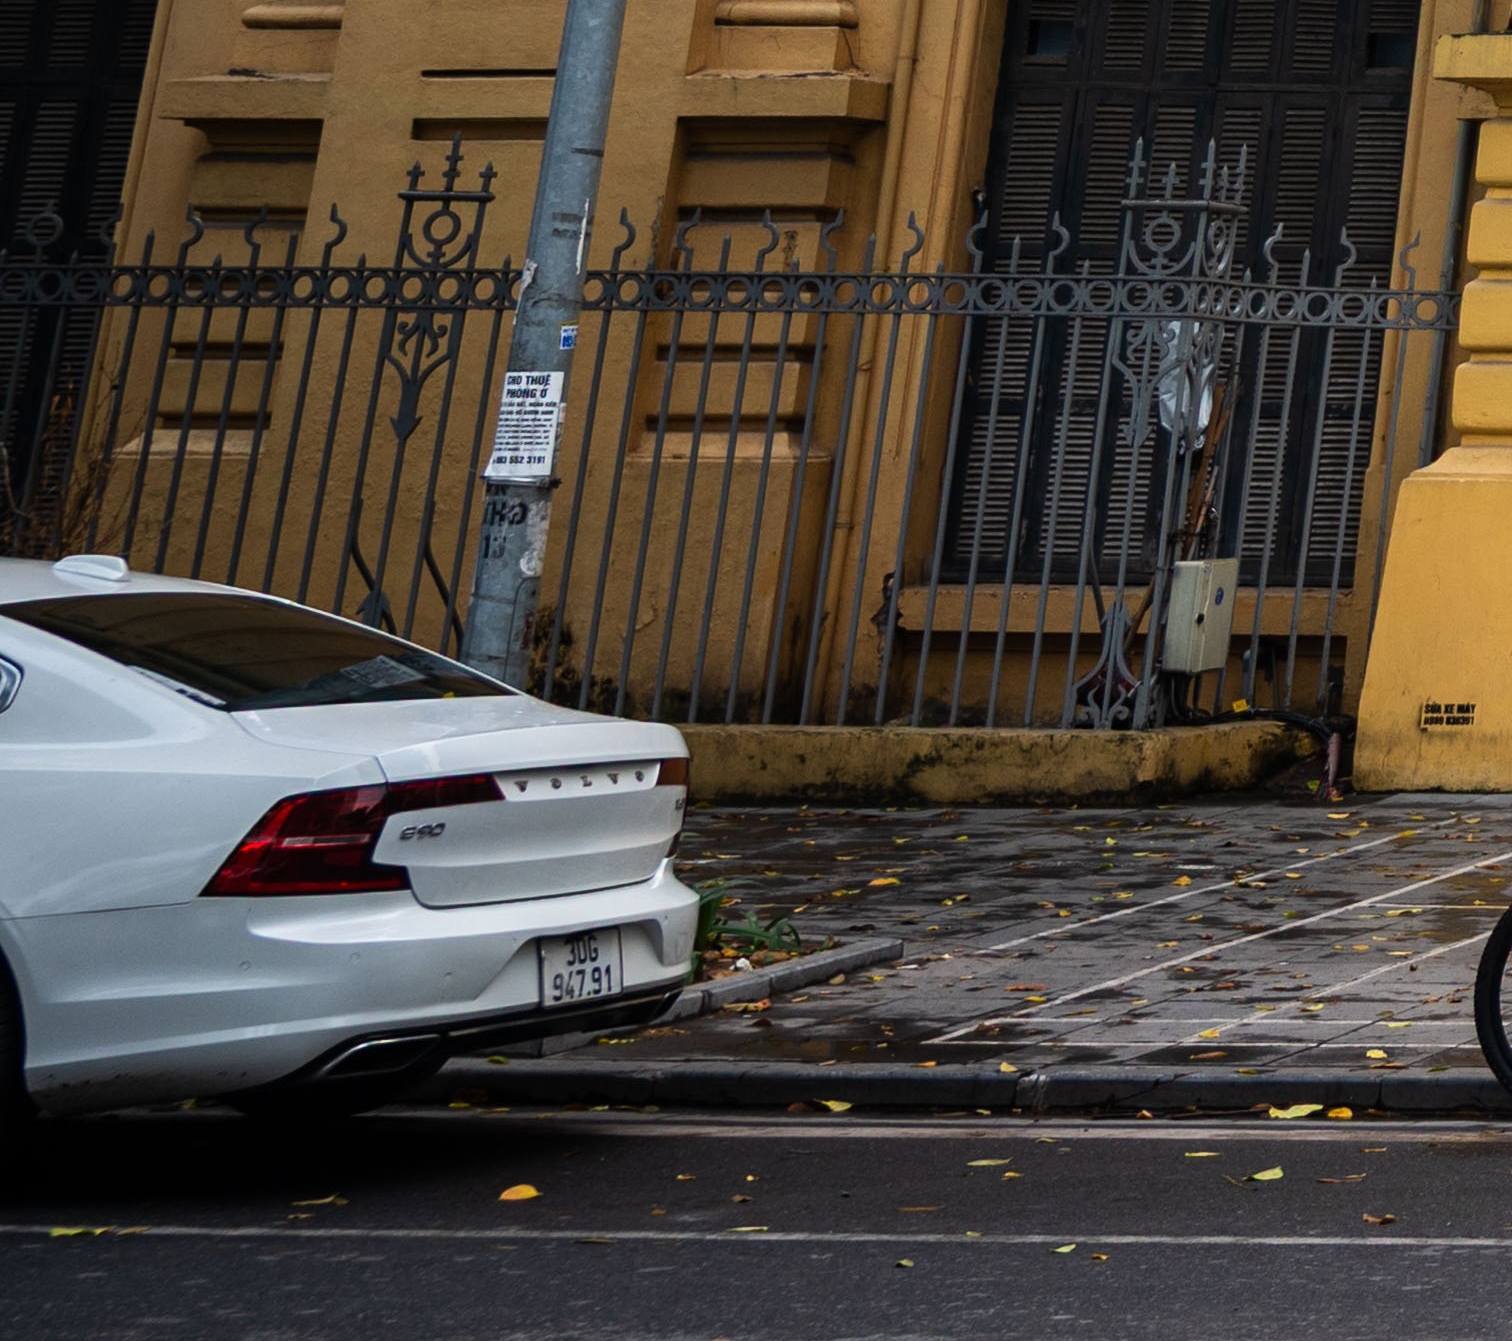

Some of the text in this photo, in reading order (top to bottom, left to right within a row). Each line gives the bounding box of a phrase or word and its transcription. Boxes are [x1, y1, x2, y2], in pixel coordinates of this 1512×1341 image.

[506, 375, 522, 386] CHO
[513, 770, 645, 793] VOLVO
[564, 934, 600, 966] 30G
[552, 964, 612, 1002] 947.91
